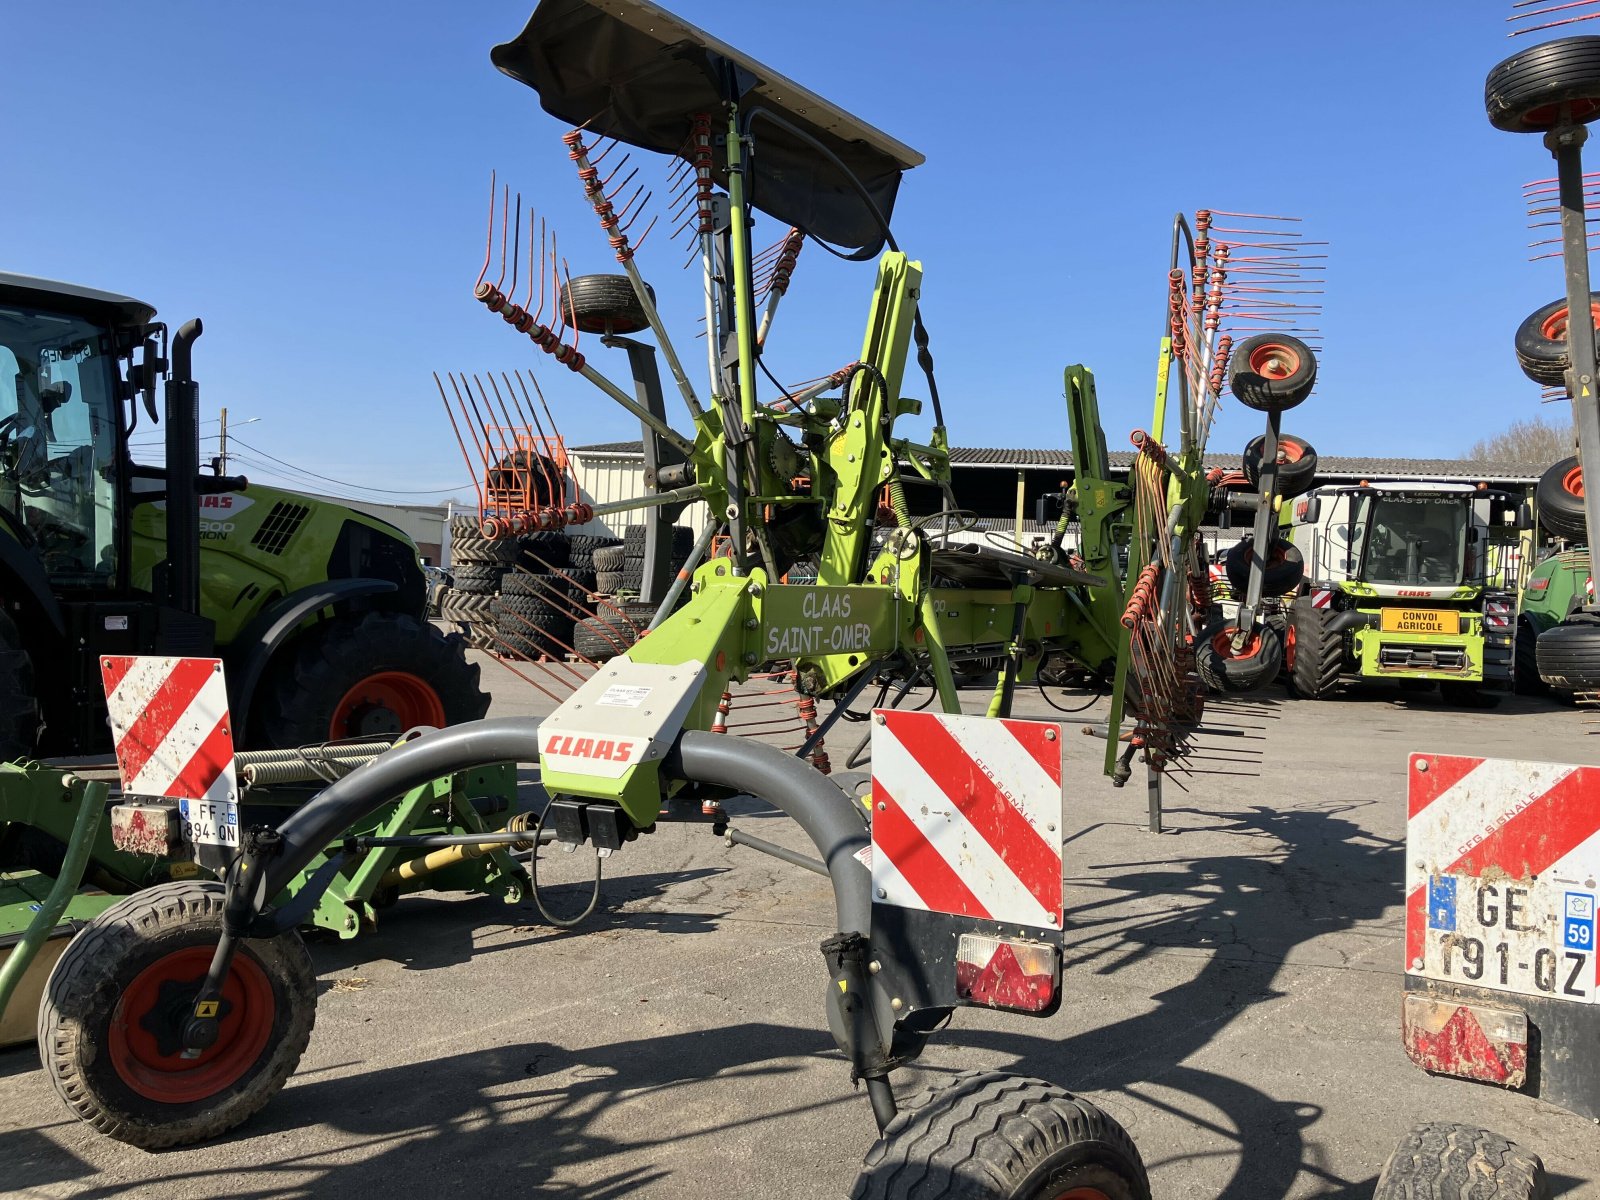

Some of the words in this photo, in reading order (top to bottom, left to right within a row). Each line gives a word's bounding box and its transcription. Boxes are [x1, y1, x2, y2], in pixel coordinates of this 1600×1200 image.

[802, 592, 851, 619] CLAAS
[1402, 611, 1438, 621] CONVOI
[1397, 621, 1443, 631] AGRICOLE
[767, 623, 871, 654] SAINT-OMER
[545, 735, 634, 762] CLAAS
[975, 758, 995, 779] CFG
[186, 822, 235, 841] 894-QN
[1457, 834, 1482, 855] CFG
[1568, 923, 1590, 945] 59
